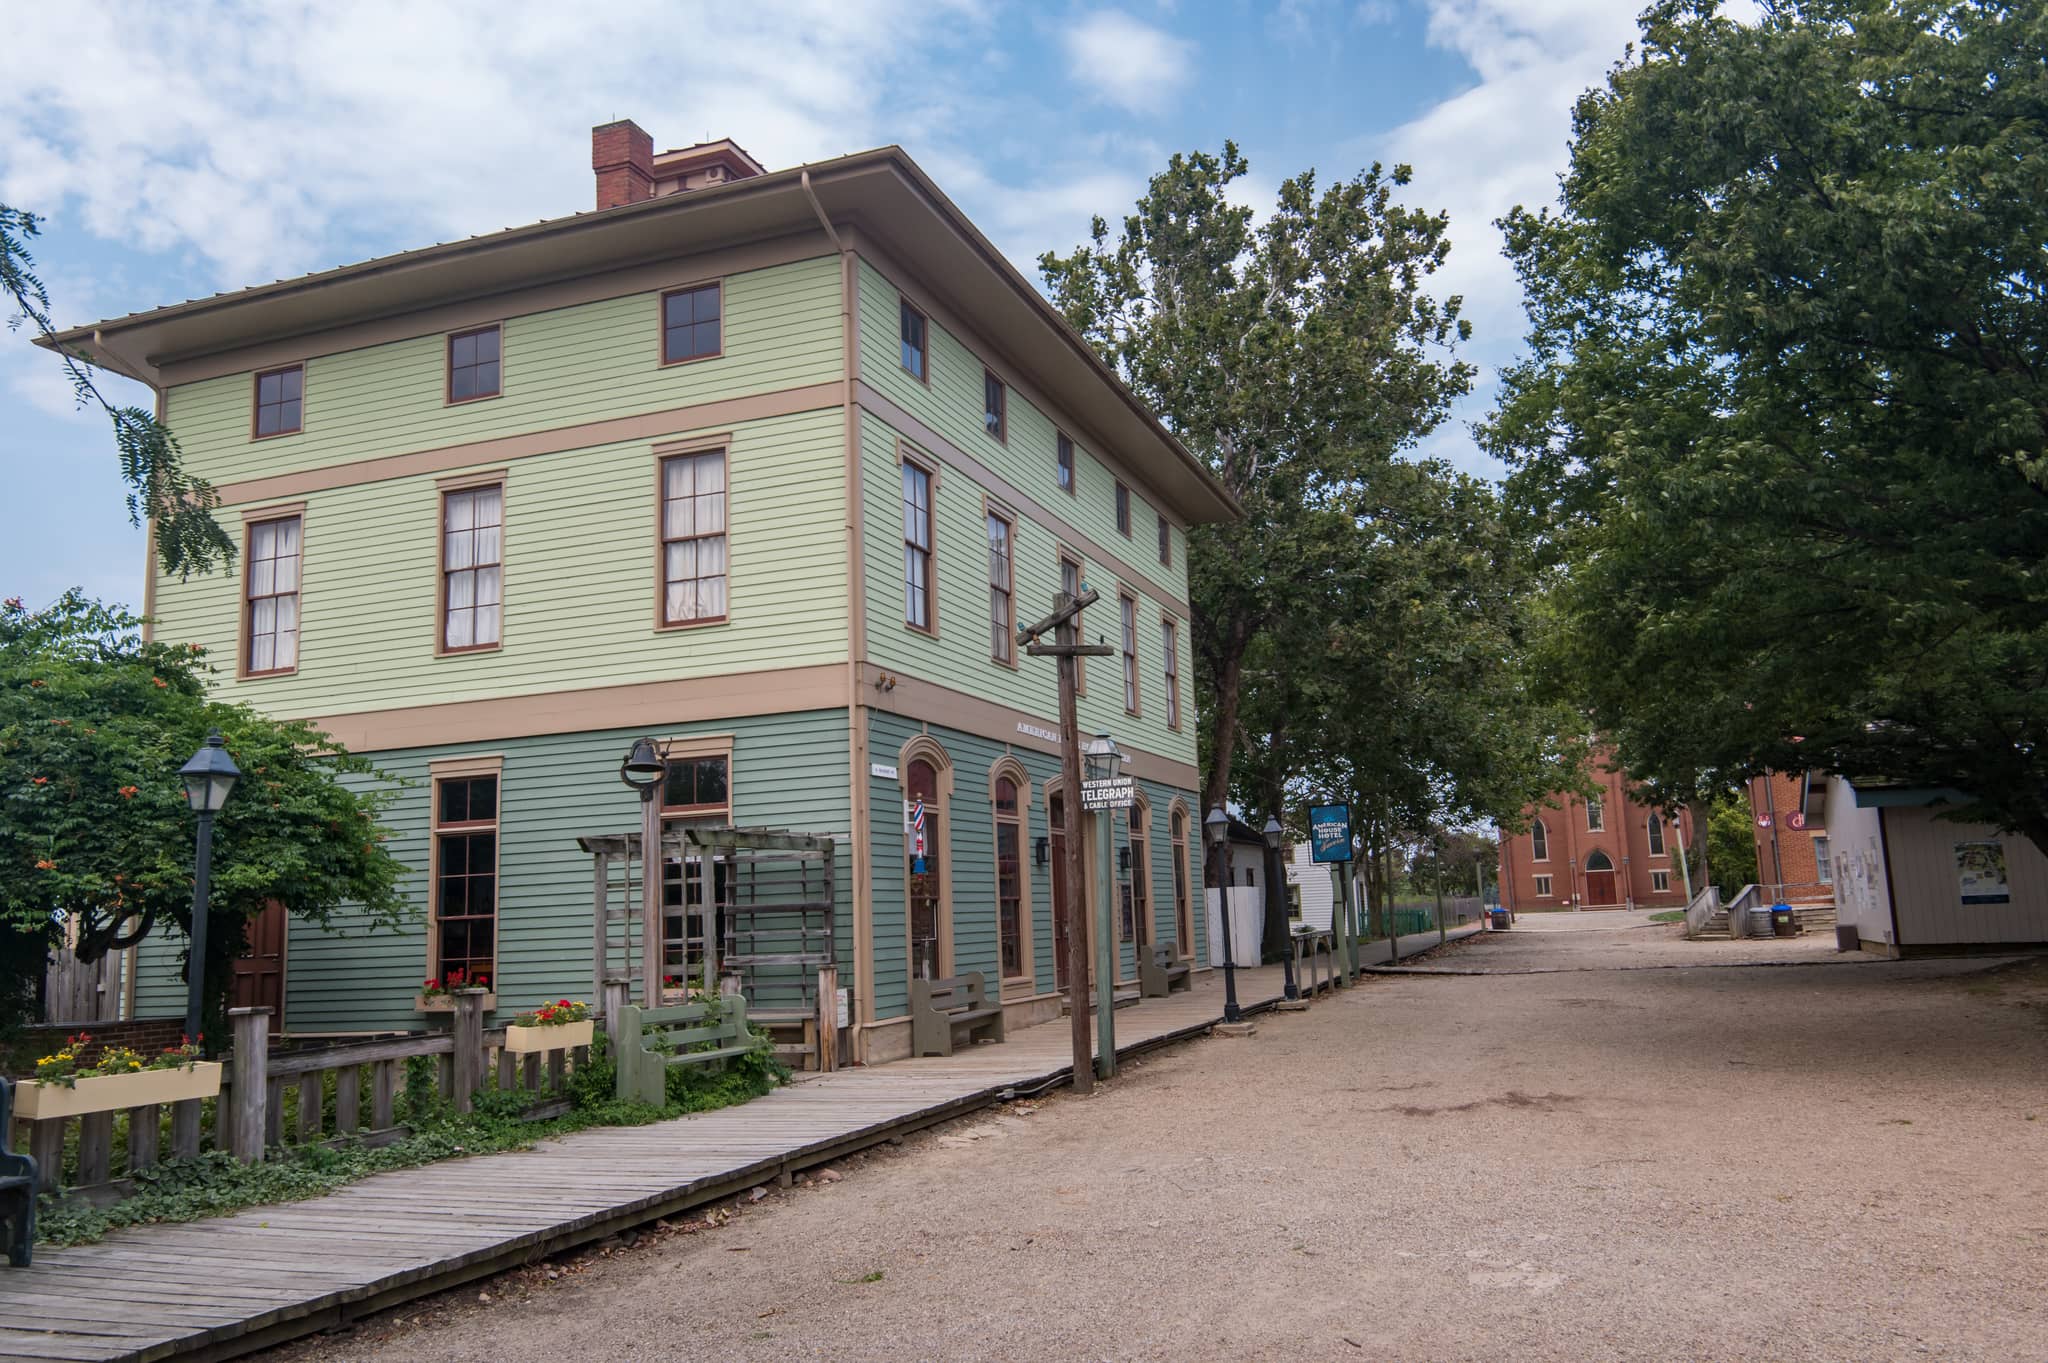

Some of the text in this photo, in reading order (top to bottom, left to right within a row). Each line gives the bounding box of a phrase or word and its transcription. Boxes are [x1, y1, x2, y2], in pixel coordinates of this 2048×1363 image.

[1016, 722, 1058, 743] AMERICAN
[1082, 777, 1132, 789] WESTERN UNION
[1081, 786, 1134, 801] TELEGRAPH
[1089, 801, 1108, 809] CABLE
[1109, 799, 1133, 808] OFFICE
[1312, 822, 1348, 831] AMERICAN
